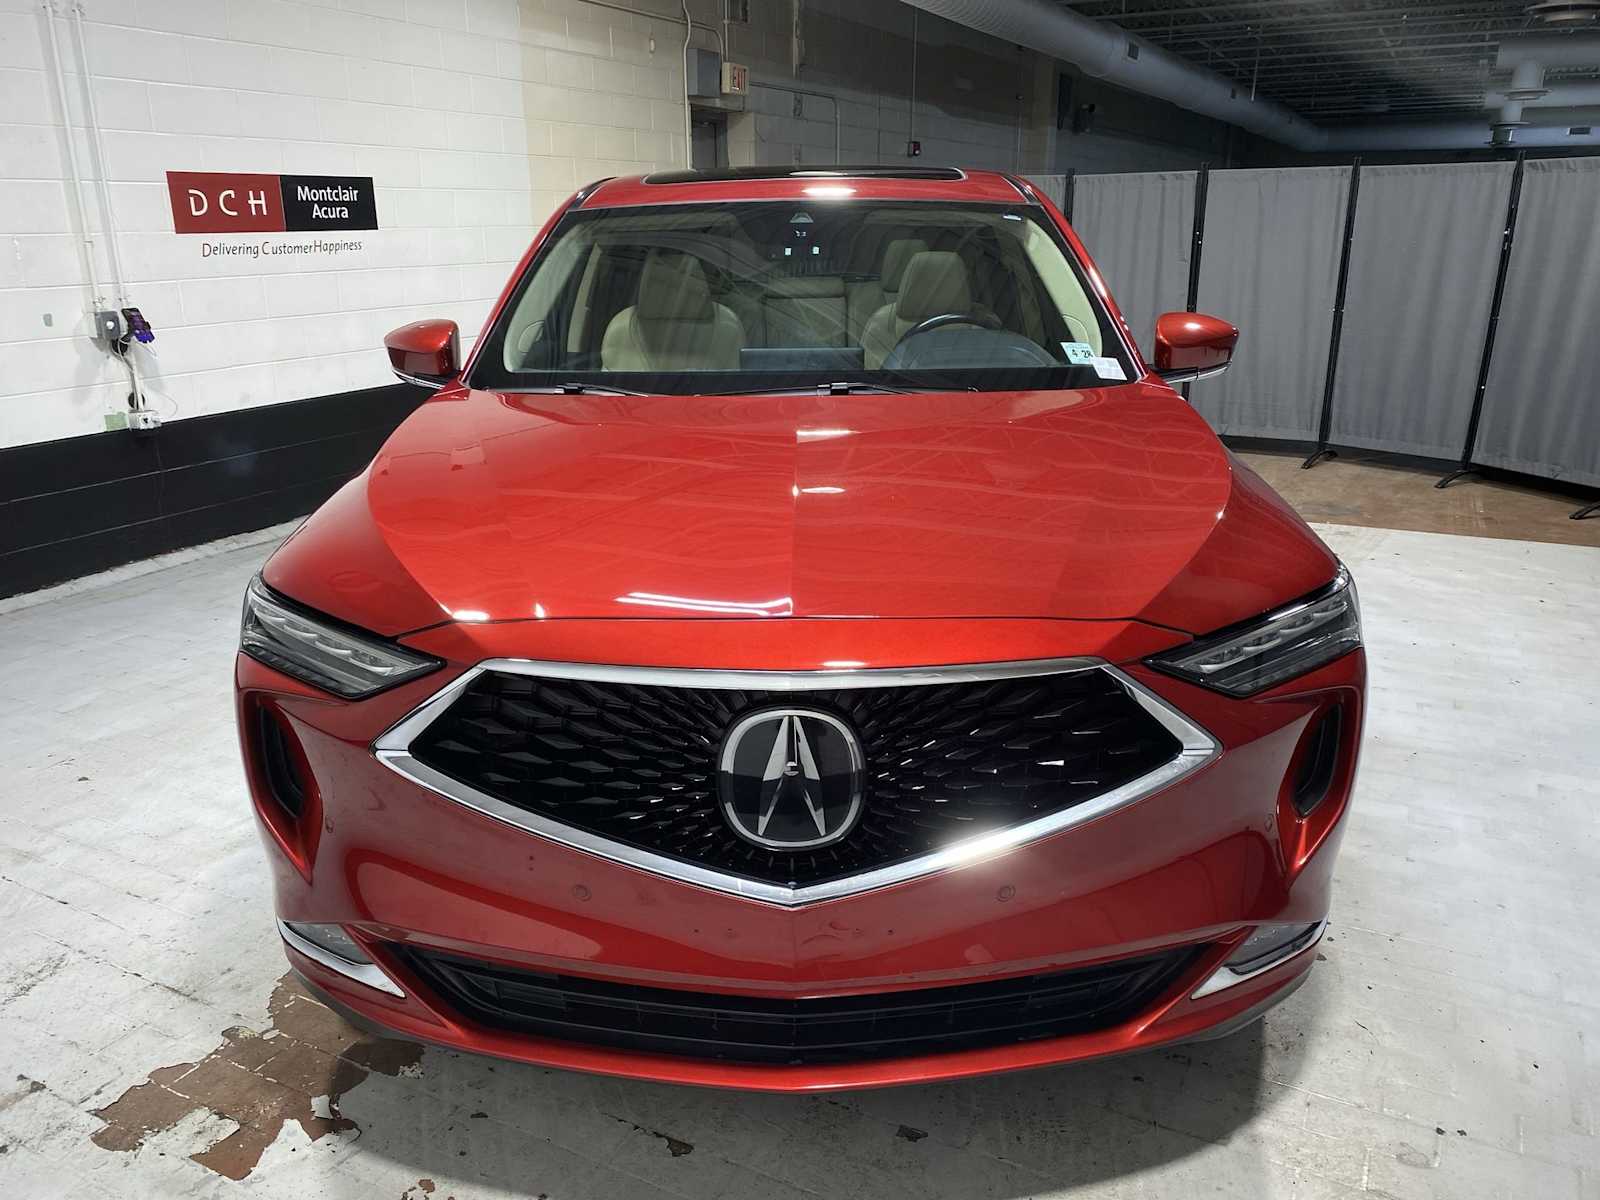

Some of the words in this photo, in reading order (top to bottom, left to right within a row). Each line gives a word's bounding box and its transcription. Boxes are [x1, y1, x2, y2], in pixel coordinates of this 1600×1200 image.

[297, 186, 359, 202] Montclair
[312, 203, 349, 219] Acura
[202, 243, 259, 258] Delivering
